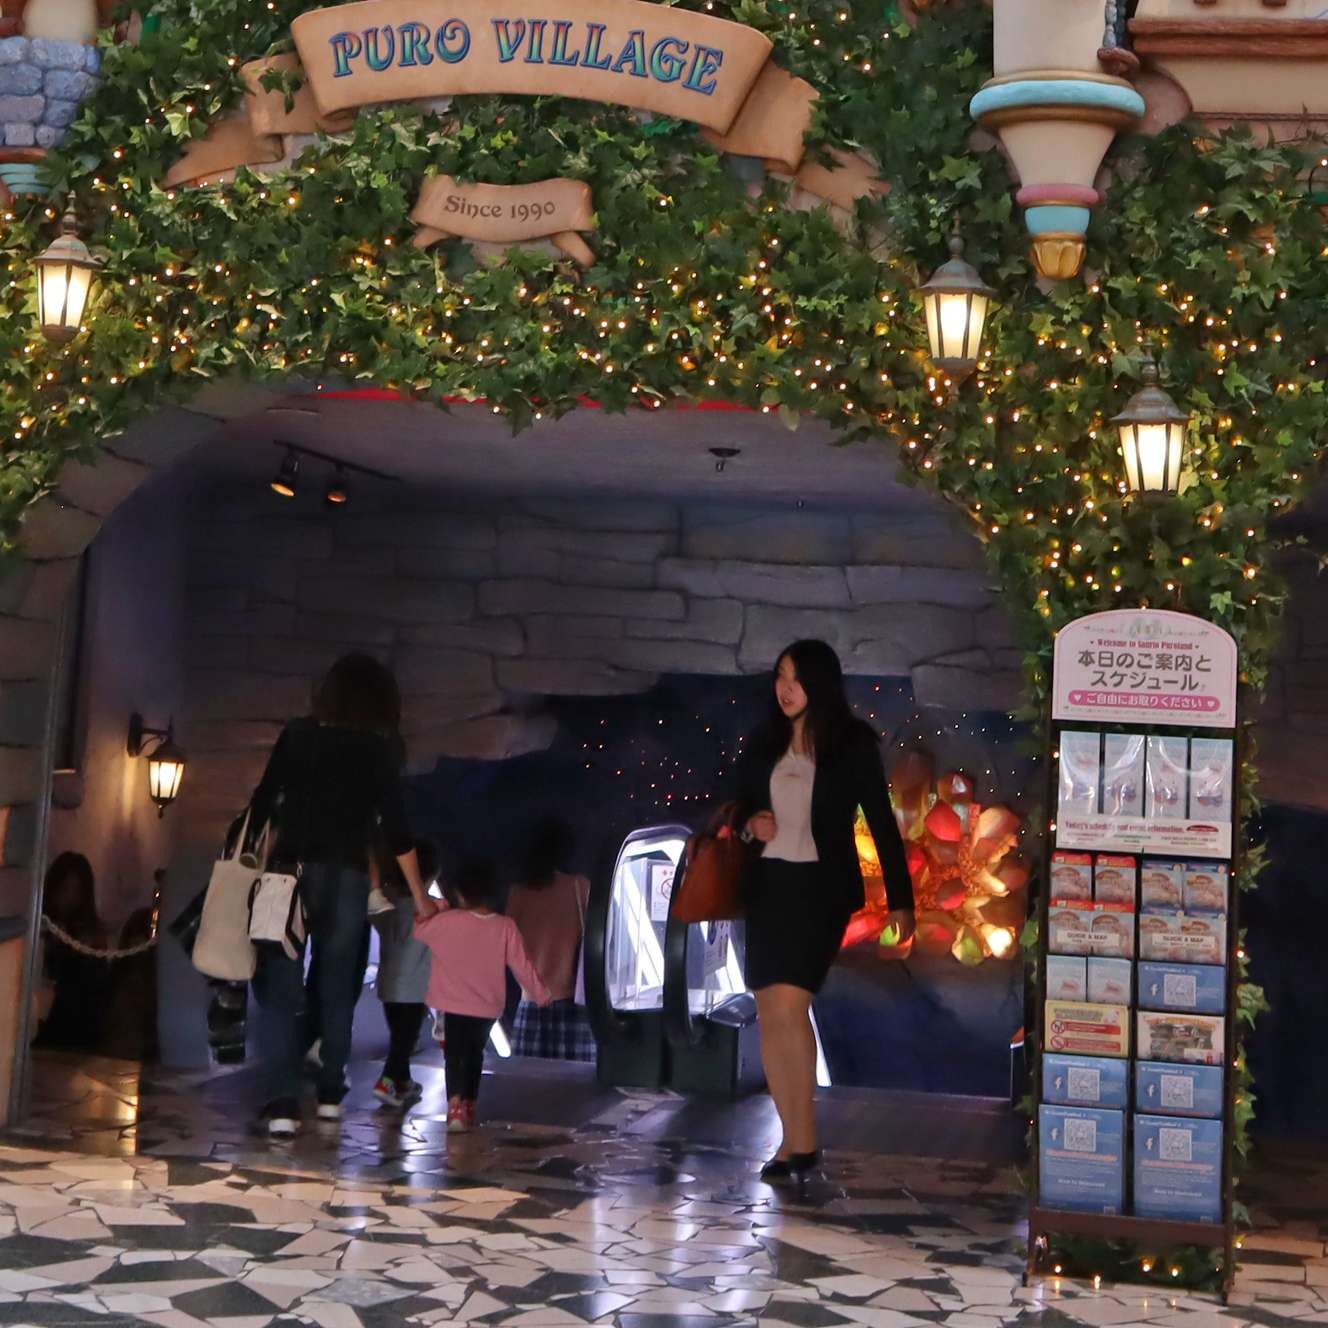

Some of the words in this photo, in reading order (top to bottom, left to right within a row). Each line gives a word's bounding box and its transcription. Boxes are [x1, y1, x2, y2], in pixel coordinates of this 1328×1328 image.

[328, 17, 471, 78] PURO
[490, 17, 724, 95] VILLAGE
[443, 195, 503, 219] Since
[508, 200, 556, 224] 1990
[1078, 650, 1212, 672] 本日のご案内と
[1090, 670, 1199, 691] スケジュール
[1086, 693, 1202, 708] ご自由にお取りください
